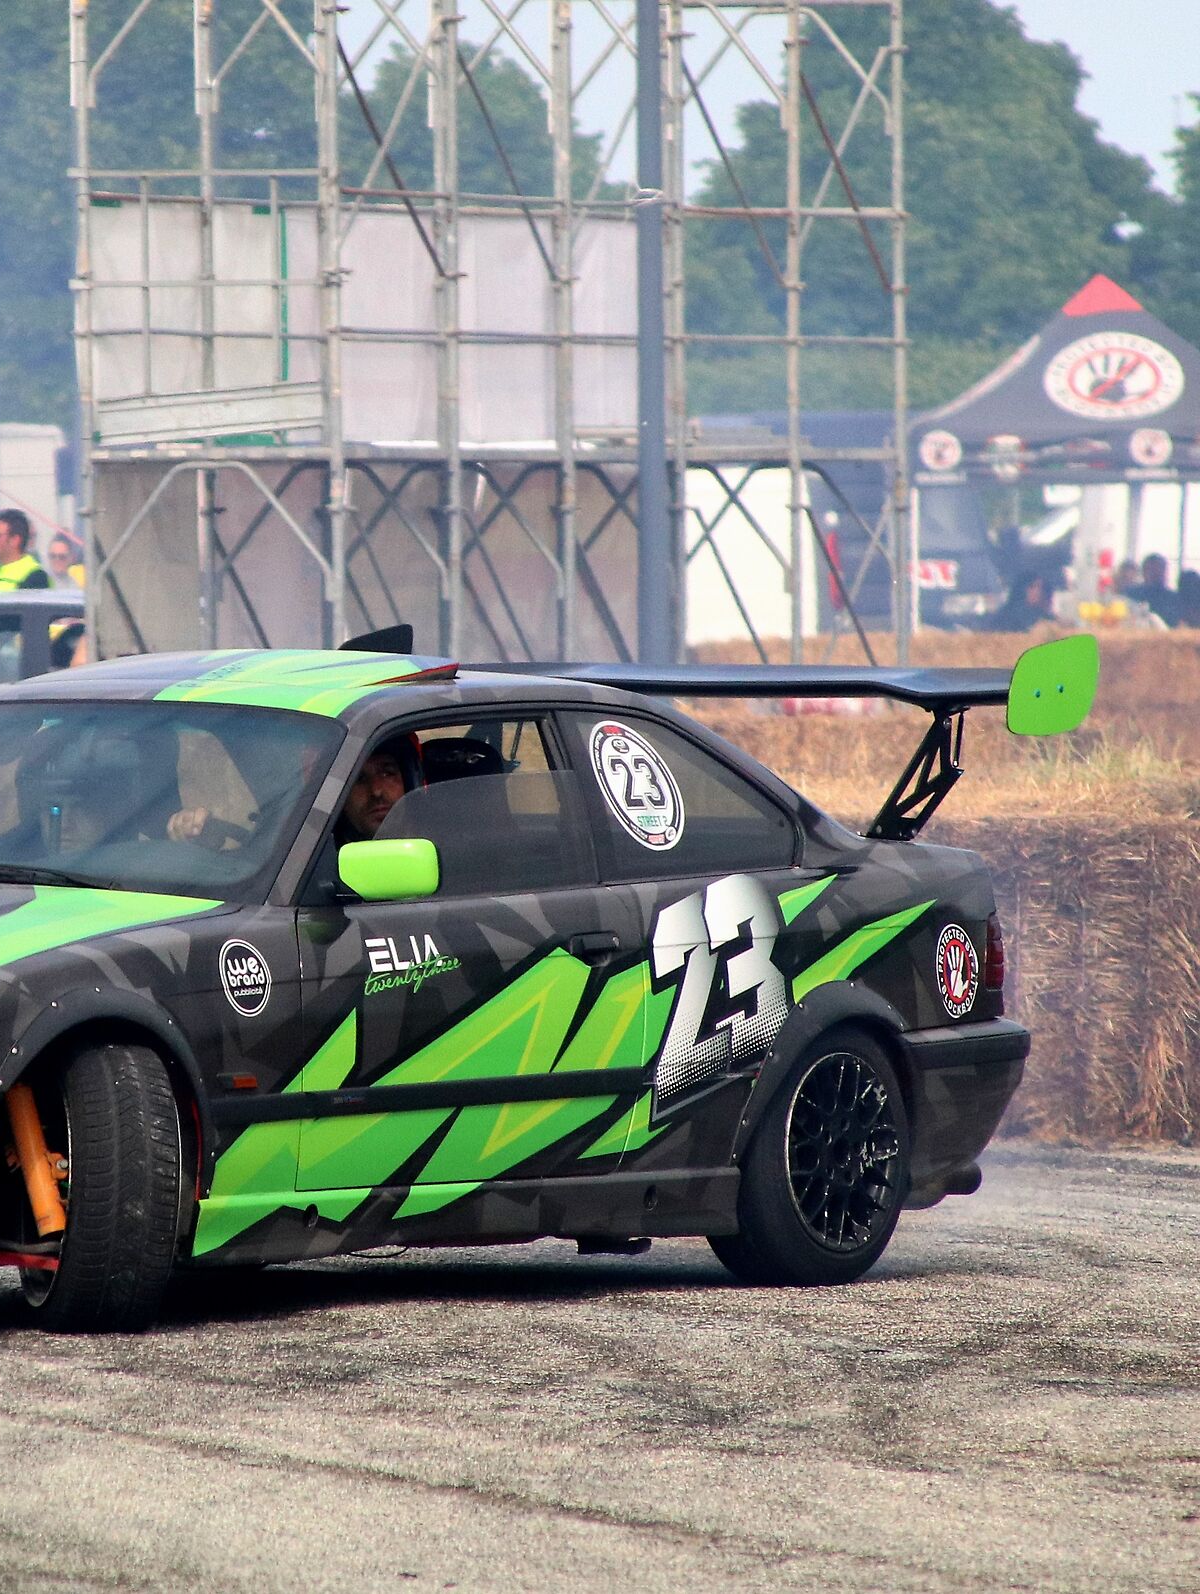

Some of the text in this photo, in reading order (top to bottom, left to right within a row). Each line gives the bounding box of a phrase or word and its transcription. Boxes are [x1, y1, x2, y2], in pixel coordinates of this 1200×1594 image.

[608, 755, 668, 810] 23
[637, 815, 662, 827] STREET
[227, 957, 259, 975] we
[365, 934, 443, 973] ELIA
[938, 928, 974, 974] PROTECTED BY
[227, 967, 265, 988] brand
[364, 954, 462, 996] twentythree
[652, 874, 789, 1102] 23
